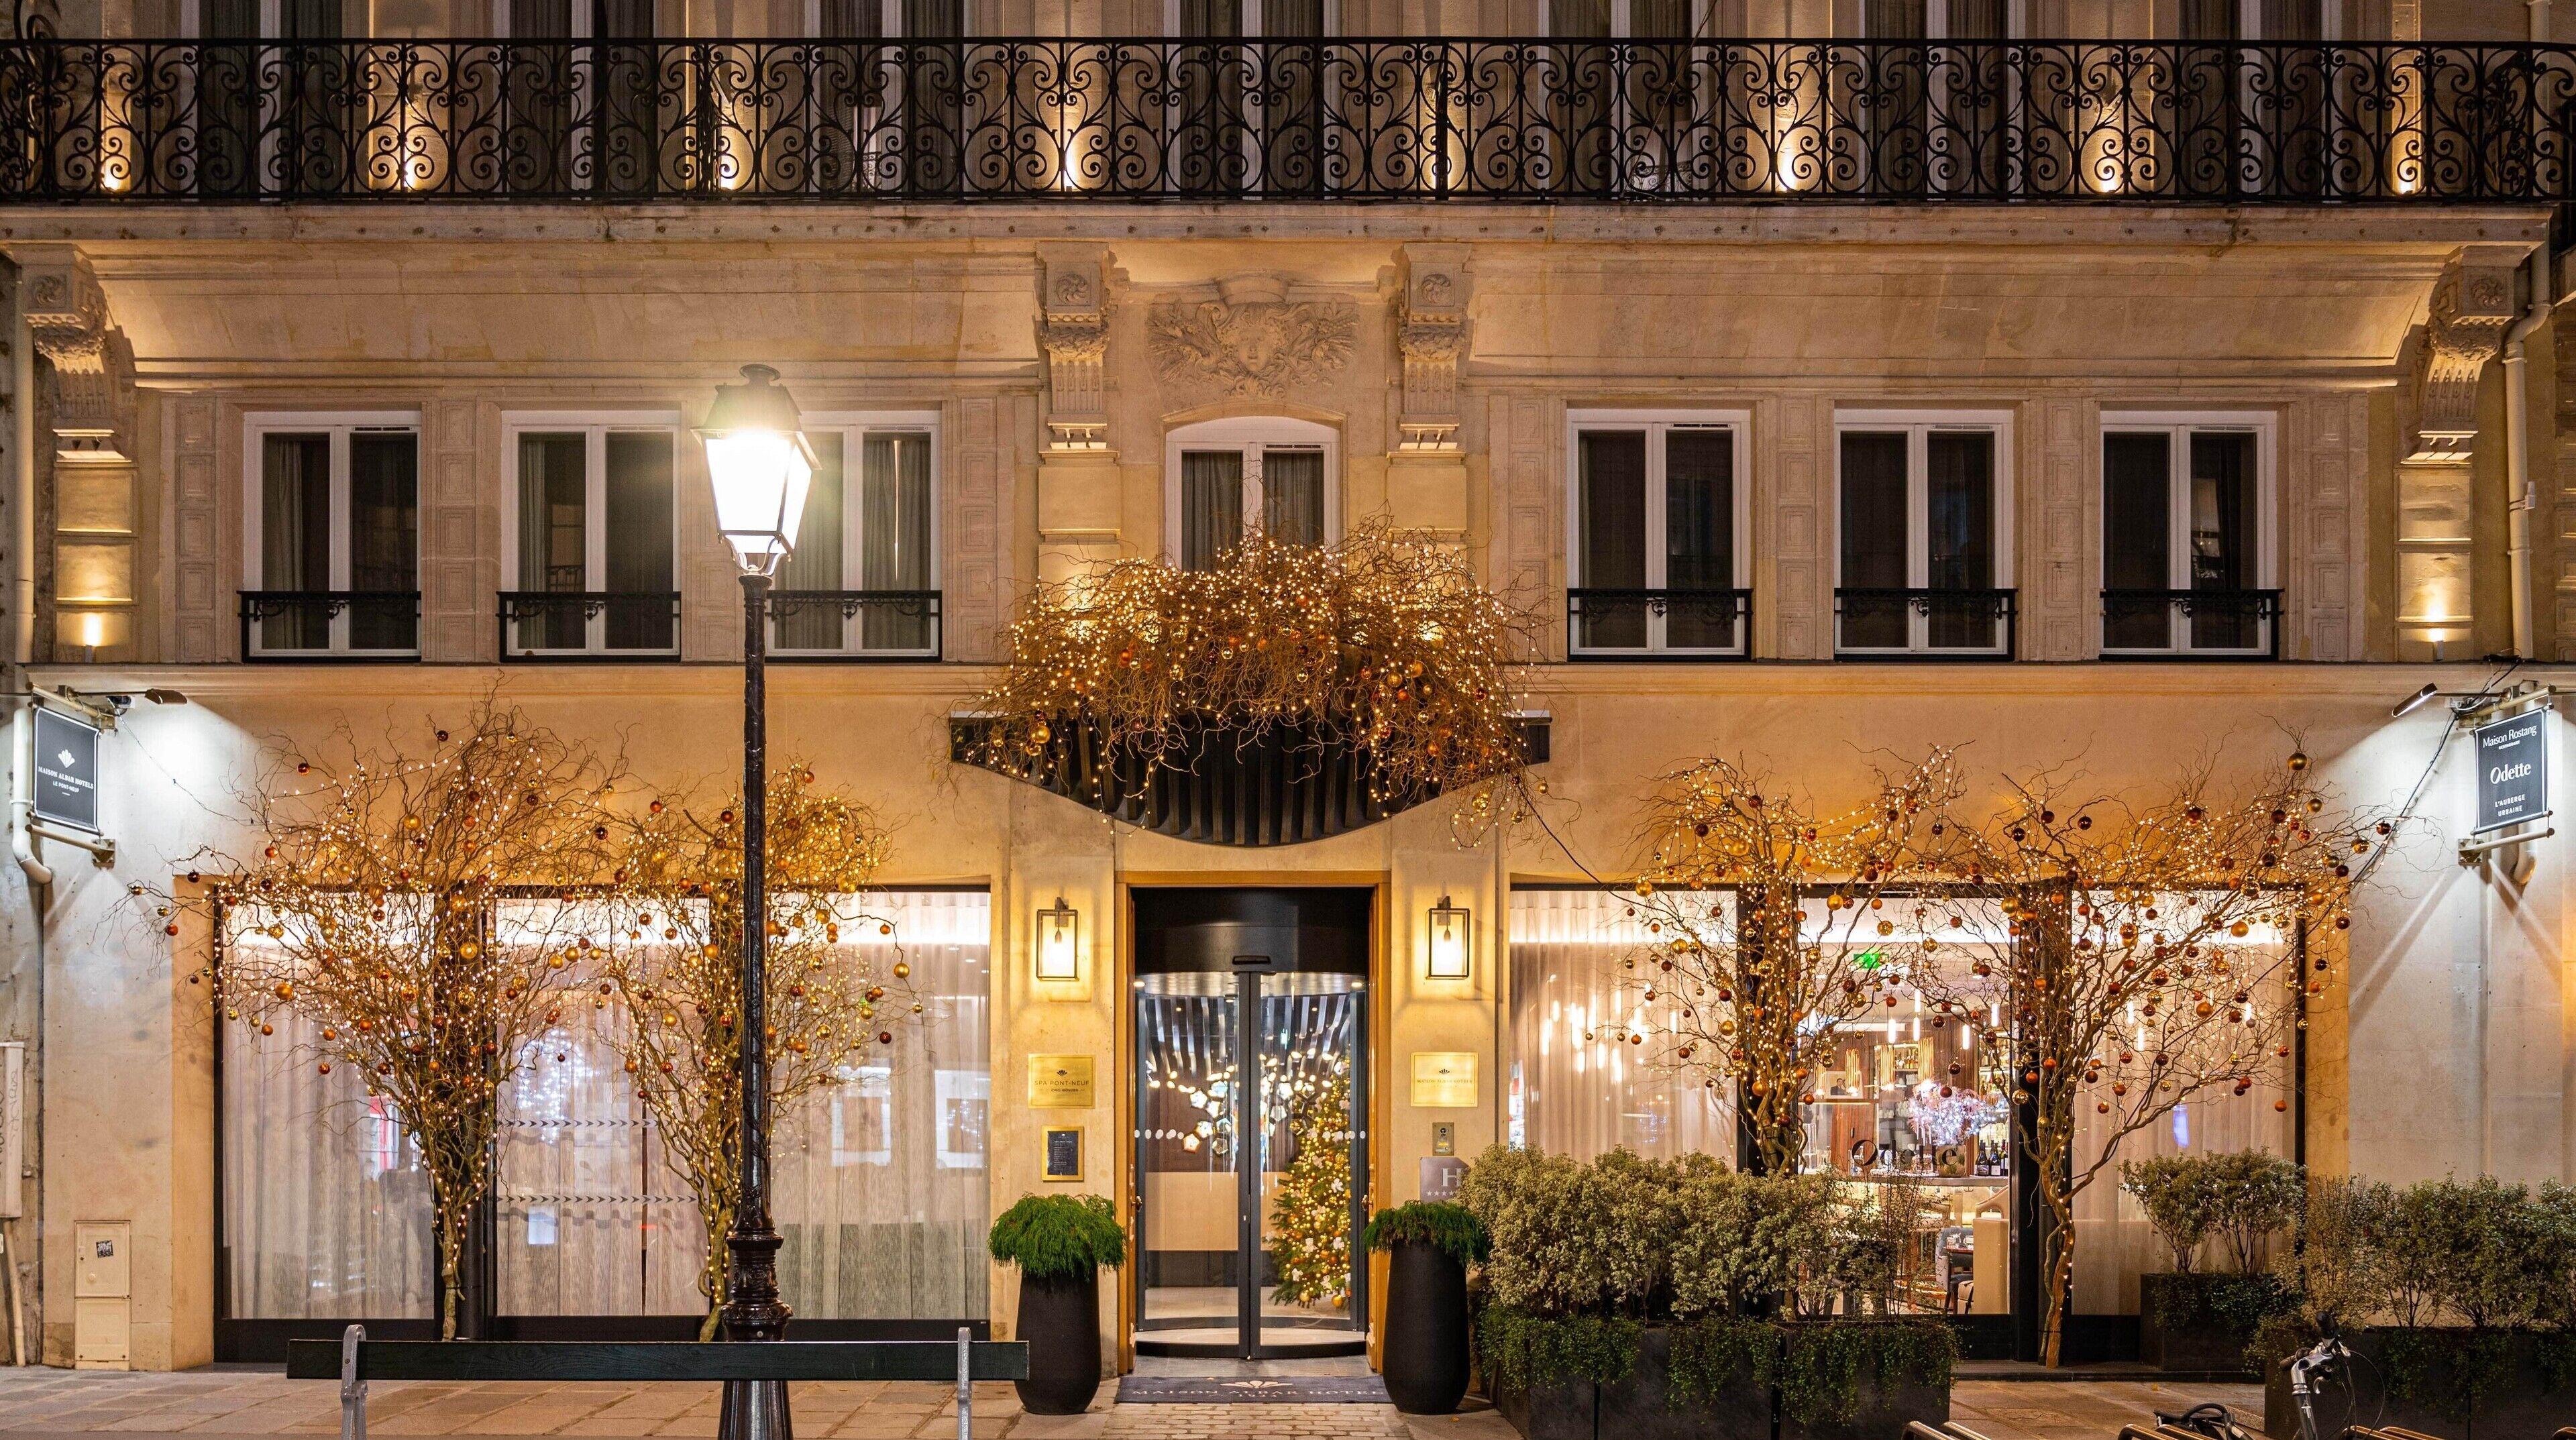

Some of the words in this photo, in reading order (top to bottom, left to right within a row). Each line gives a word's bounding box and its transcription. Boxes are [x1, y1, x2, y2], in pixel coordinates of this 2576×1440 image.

[2483, 734, 2508, 749] Maison
[2508, 725, 2537, 740] Rostang
[38, 766, 58, 777] MAISON
[74, 778, 94, 789] HOTELS
[2490, 763, 2531, 784] Odette
[2495, 794, 2526, 808] L'AUBERGE
[2498, 805, 2523, 817] URBAINE
[1441, 1168, 1463, 1187] H
